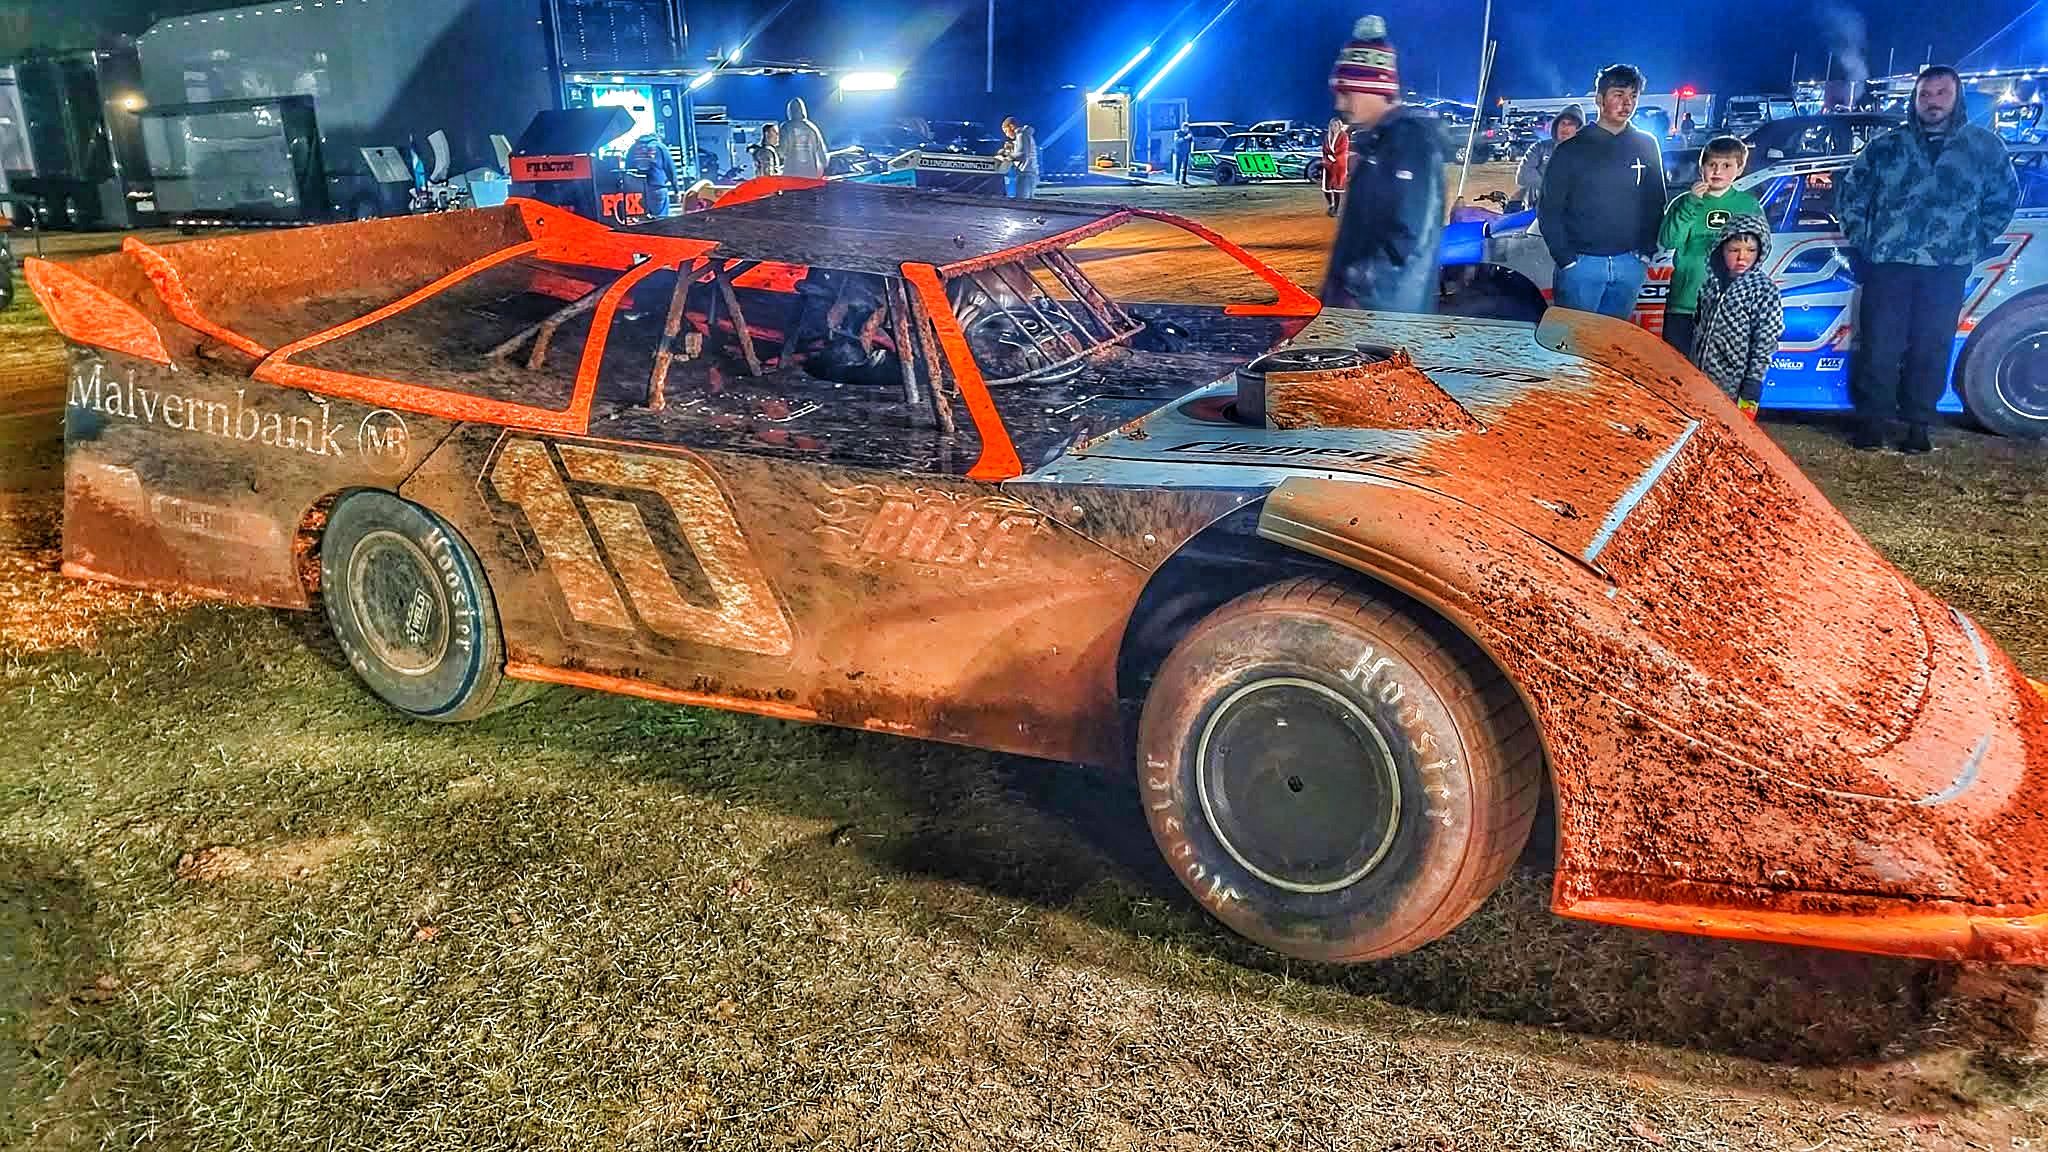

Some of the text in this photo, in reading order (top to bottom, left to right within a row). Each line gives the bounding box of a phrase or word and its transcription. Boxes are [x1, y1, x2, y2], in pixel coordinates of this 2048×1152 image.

[1236, 153, 1277, 173] 08
[601, 192, 645, 217] FOX
[1820, 358, 1841, 369] WIX
[69, 364, 345, 458] Malvernbank
[482, 434, 794, 656] 10
[1340, 645, 1456, 828] Hoosier
